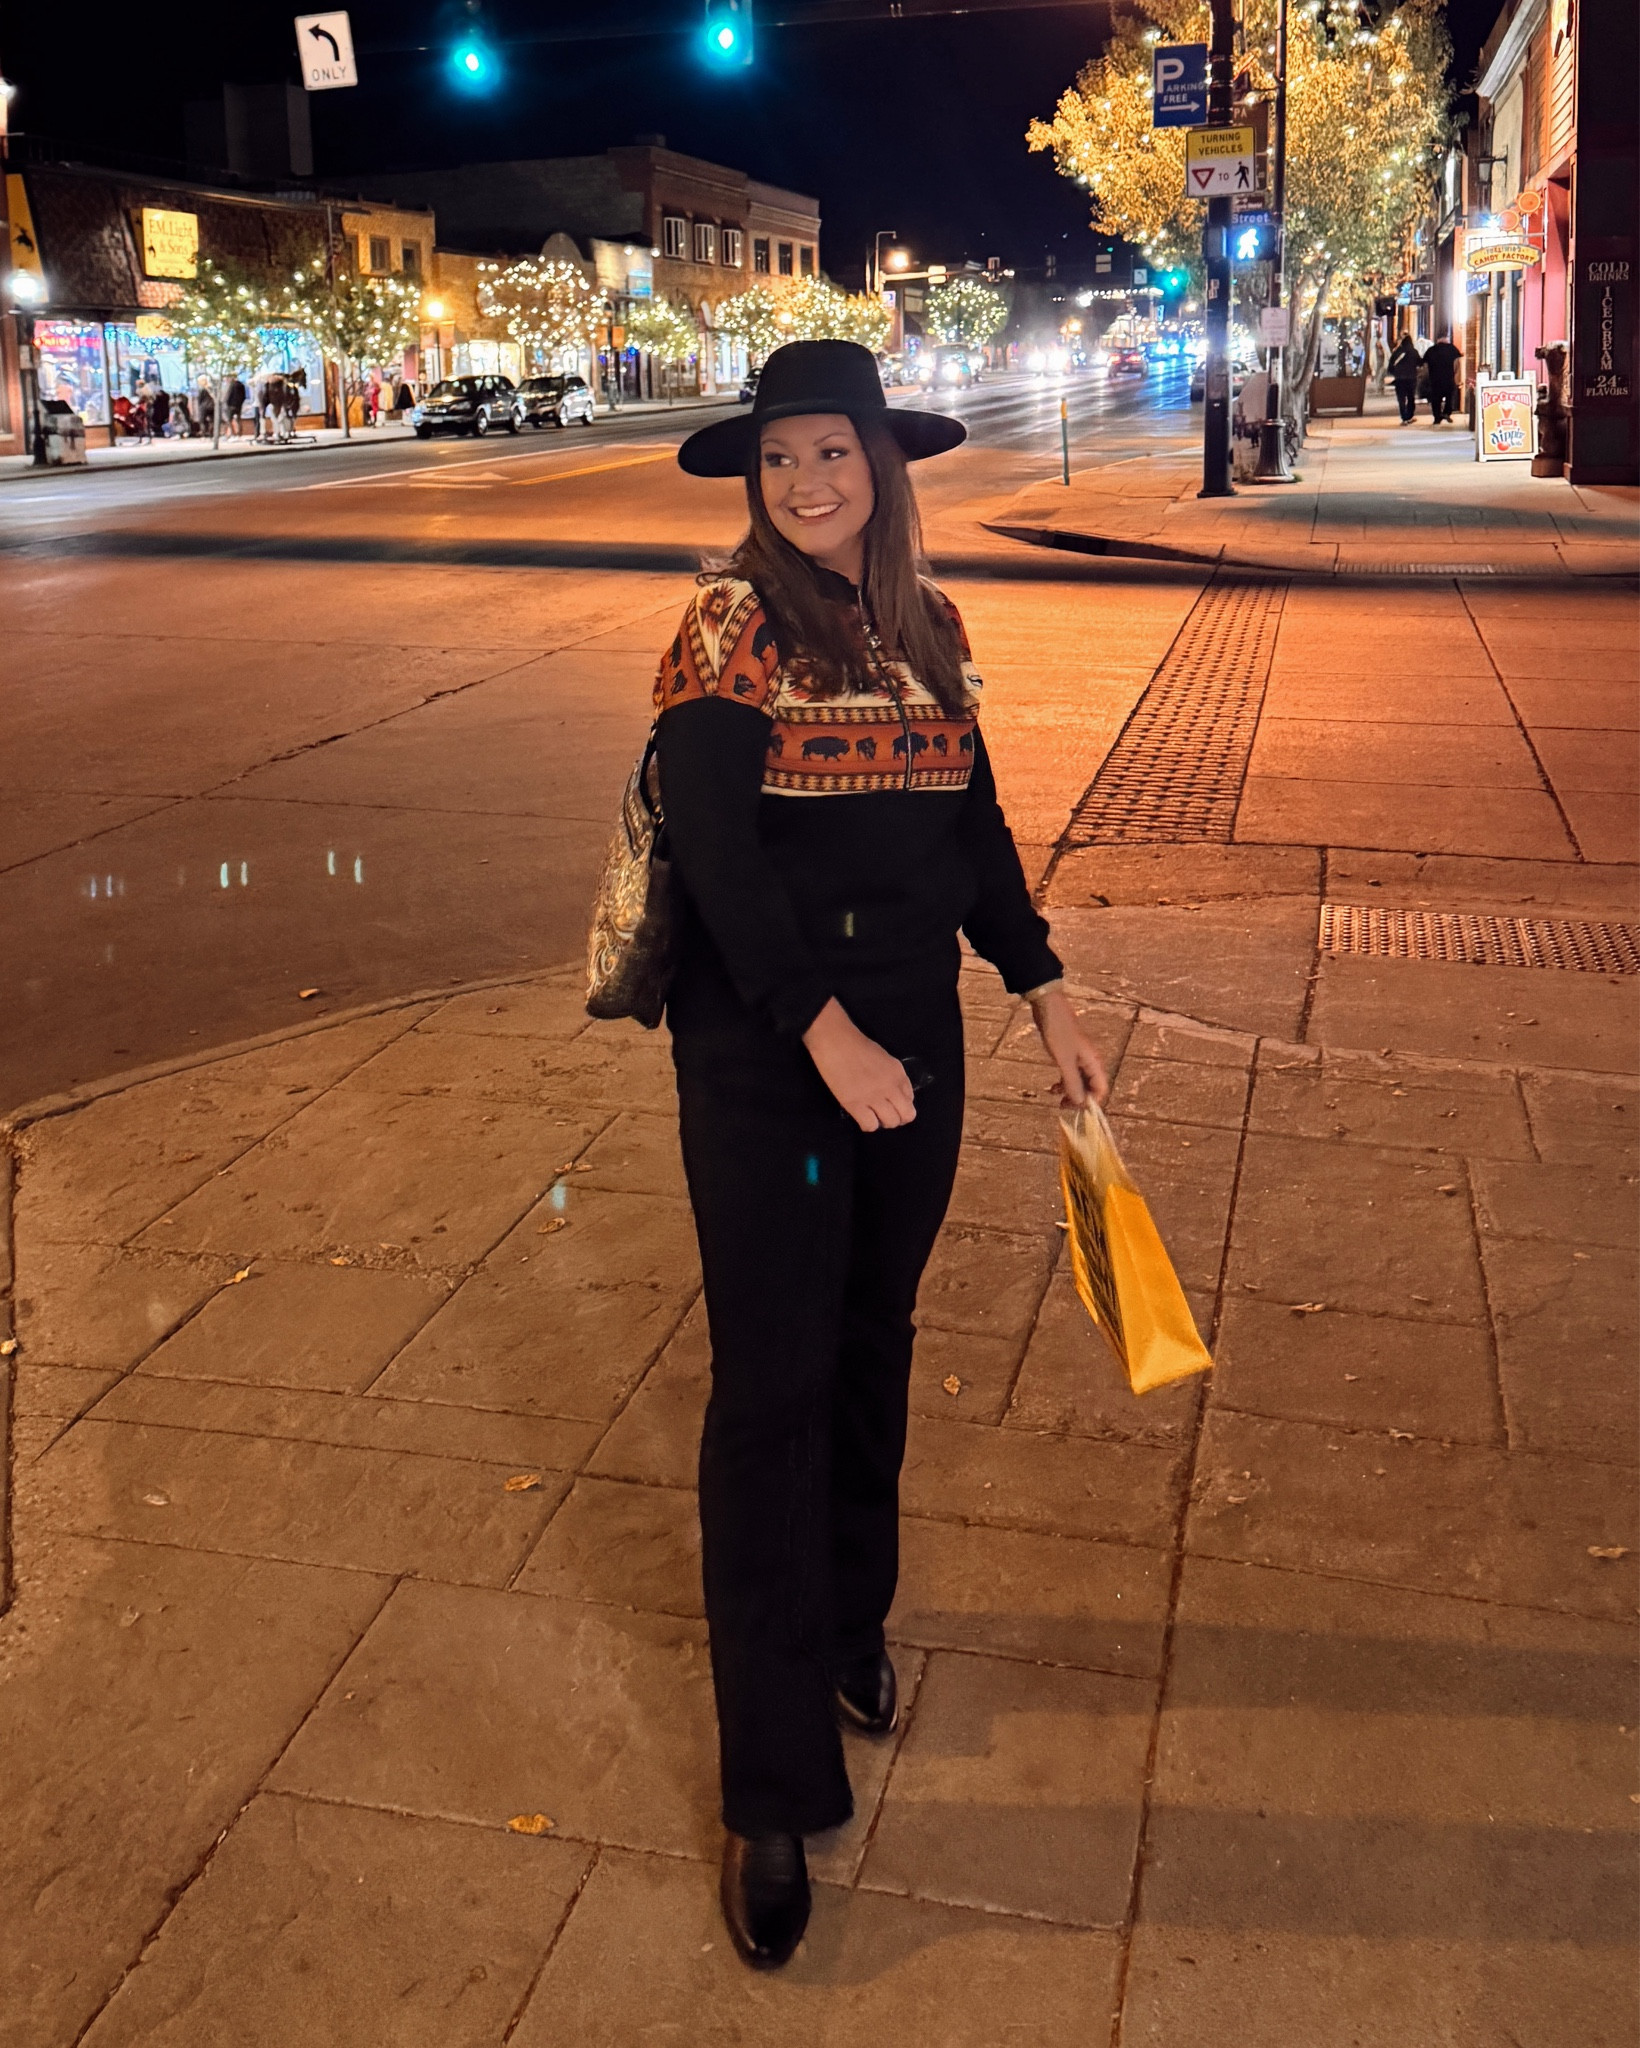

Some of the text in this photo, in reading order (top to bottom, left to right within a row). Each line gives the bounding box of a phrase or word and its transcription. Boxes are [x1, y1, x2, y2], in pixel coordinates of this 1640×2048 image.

[311, 66, 347, 81] ONLY
[1163, 94, 1188, 104] FREE
[1201, 132, 1241, 144] TURNING
[1198, 144, 1243, 156] VEHICLES
[1218, 172, 1230, 181] TO
[1231, 212, 1269, 224] Street
[1474, 253, 1535, 266] CANDY FACTORY
[1588, 261, 1630, 274] COLD
[1588, 271, 1630, 281] DRINKS
[1600, 286, 1613, 370] ICE CREAM
[1586, 387, 1629, 396] FLAVORS
